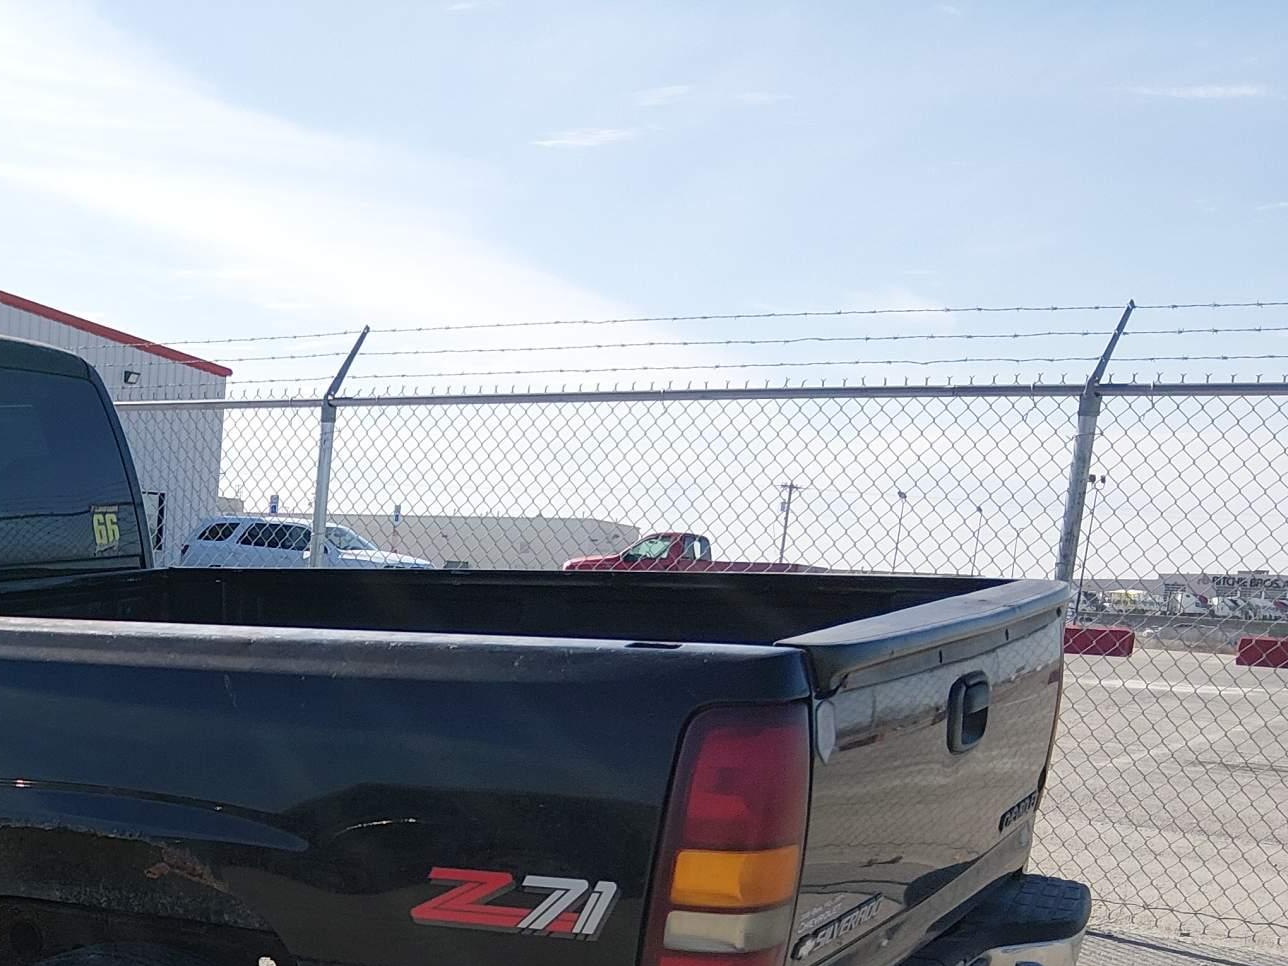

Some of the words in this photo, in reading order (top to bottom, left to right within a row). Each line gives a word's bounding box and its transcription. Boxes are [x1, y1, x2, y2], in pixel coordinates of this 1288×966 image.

[93, 513, 120, 545] 66
[410, 866, 618, 937] Z71
[813, 896, 885, 952] SILVERADO
